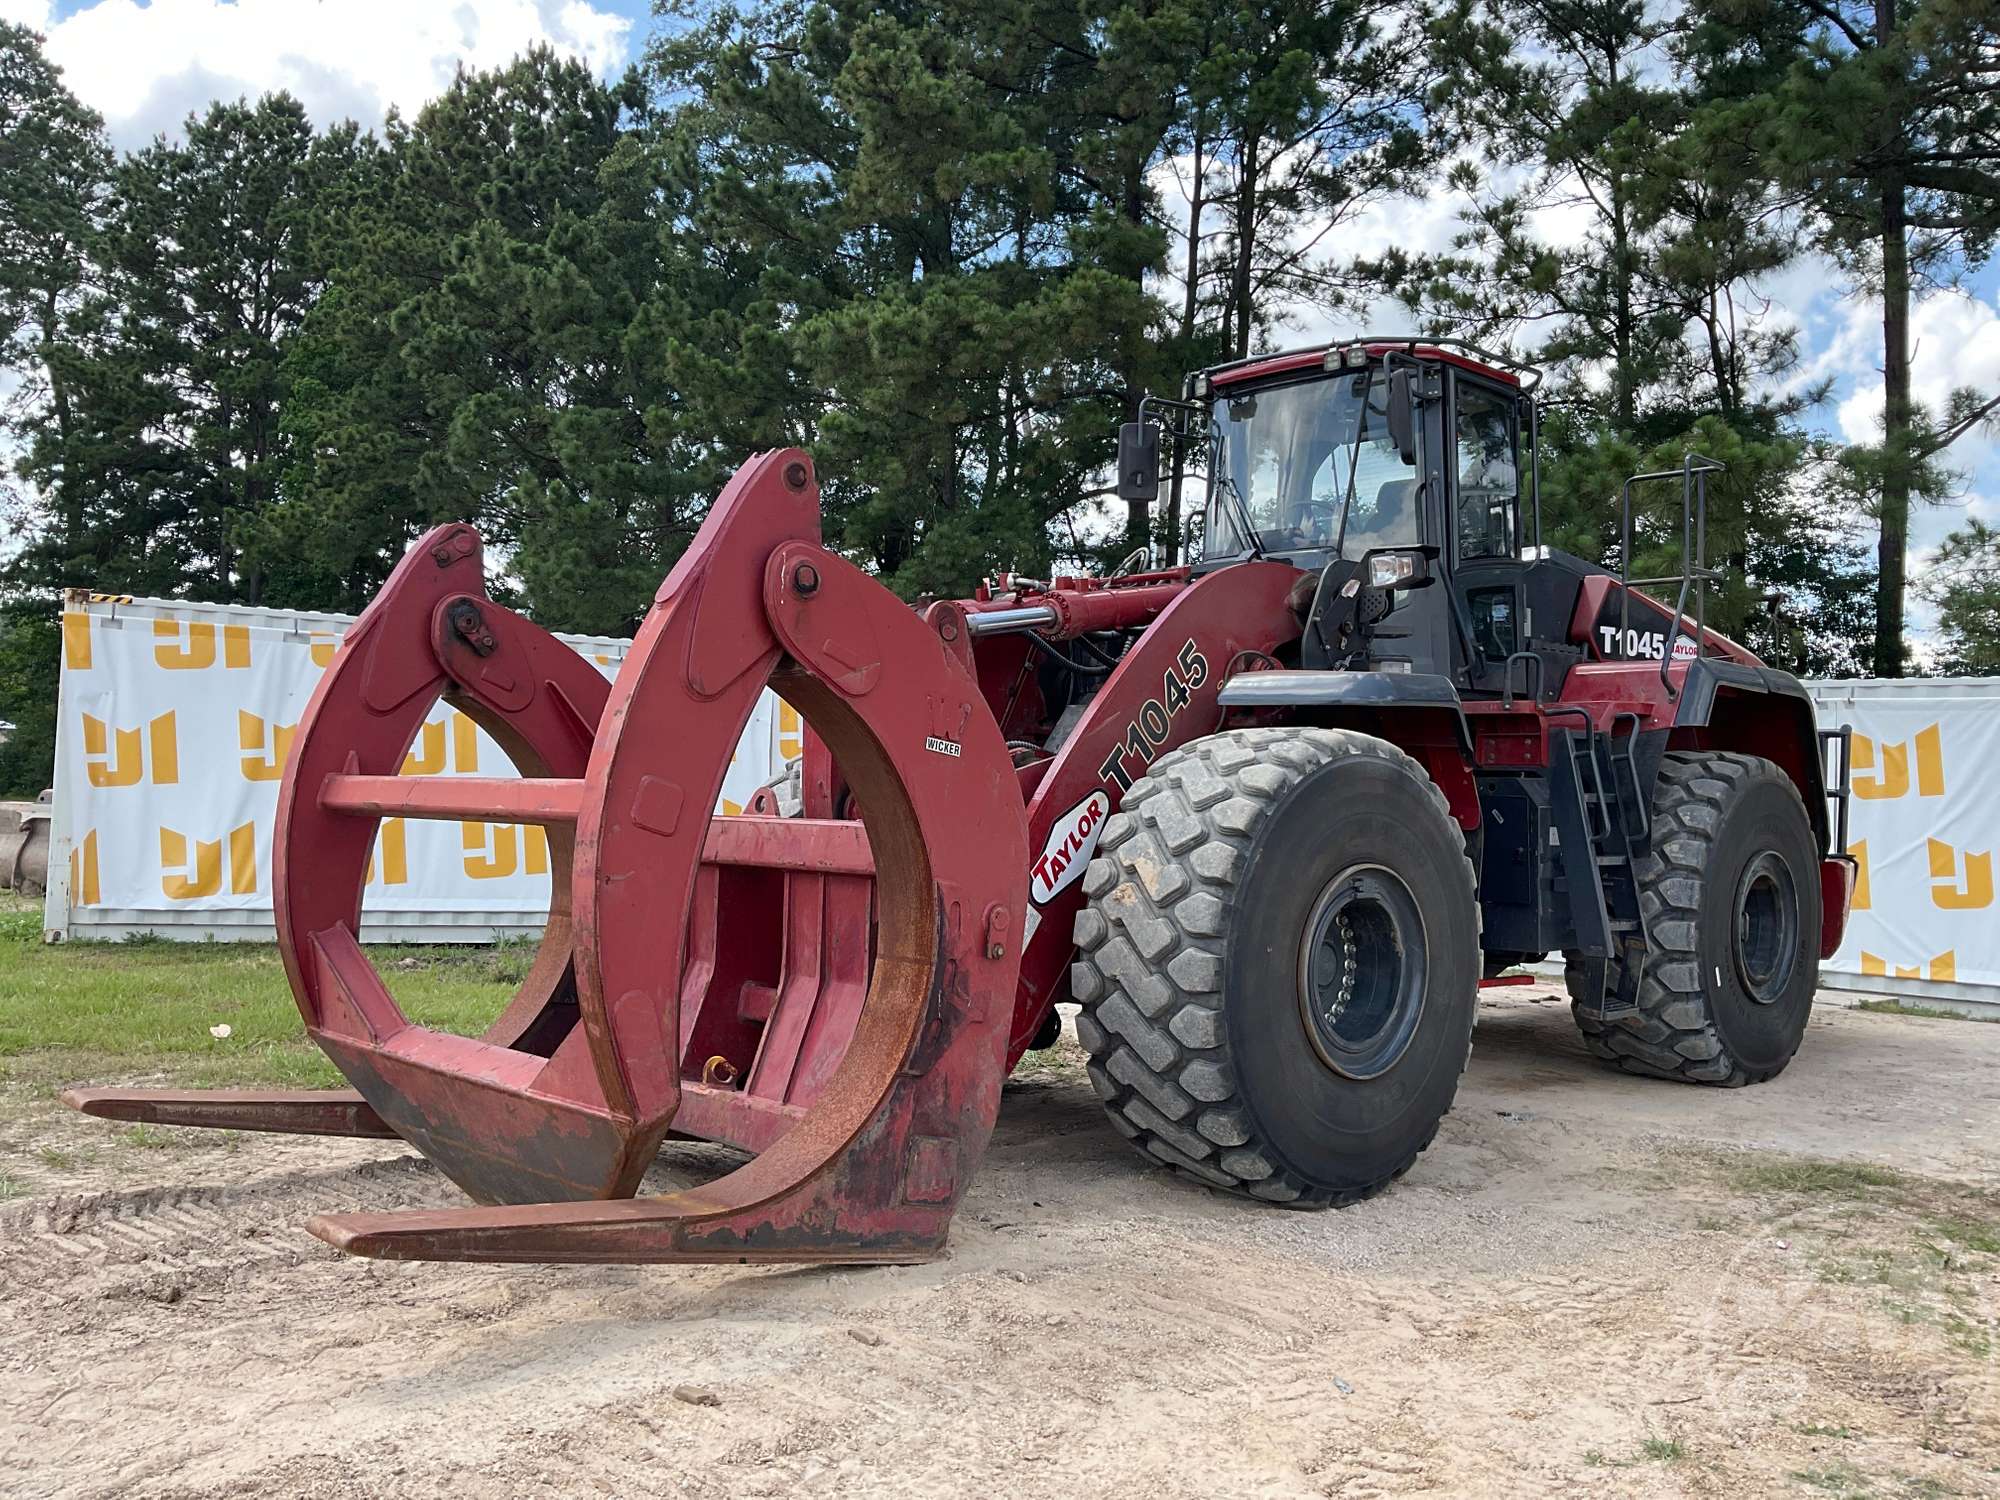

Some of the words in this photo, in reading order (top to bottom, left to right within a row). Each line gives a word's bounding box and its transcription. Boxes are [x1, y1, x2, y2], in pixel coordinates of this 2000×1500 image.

[1673, 644, 1697, 656] AYLOR
[1098, 638, 1209, 793] T1045
[927, 738, 960, 756] WICKER
[1032, 798, 1105, 893] TAYLOR
